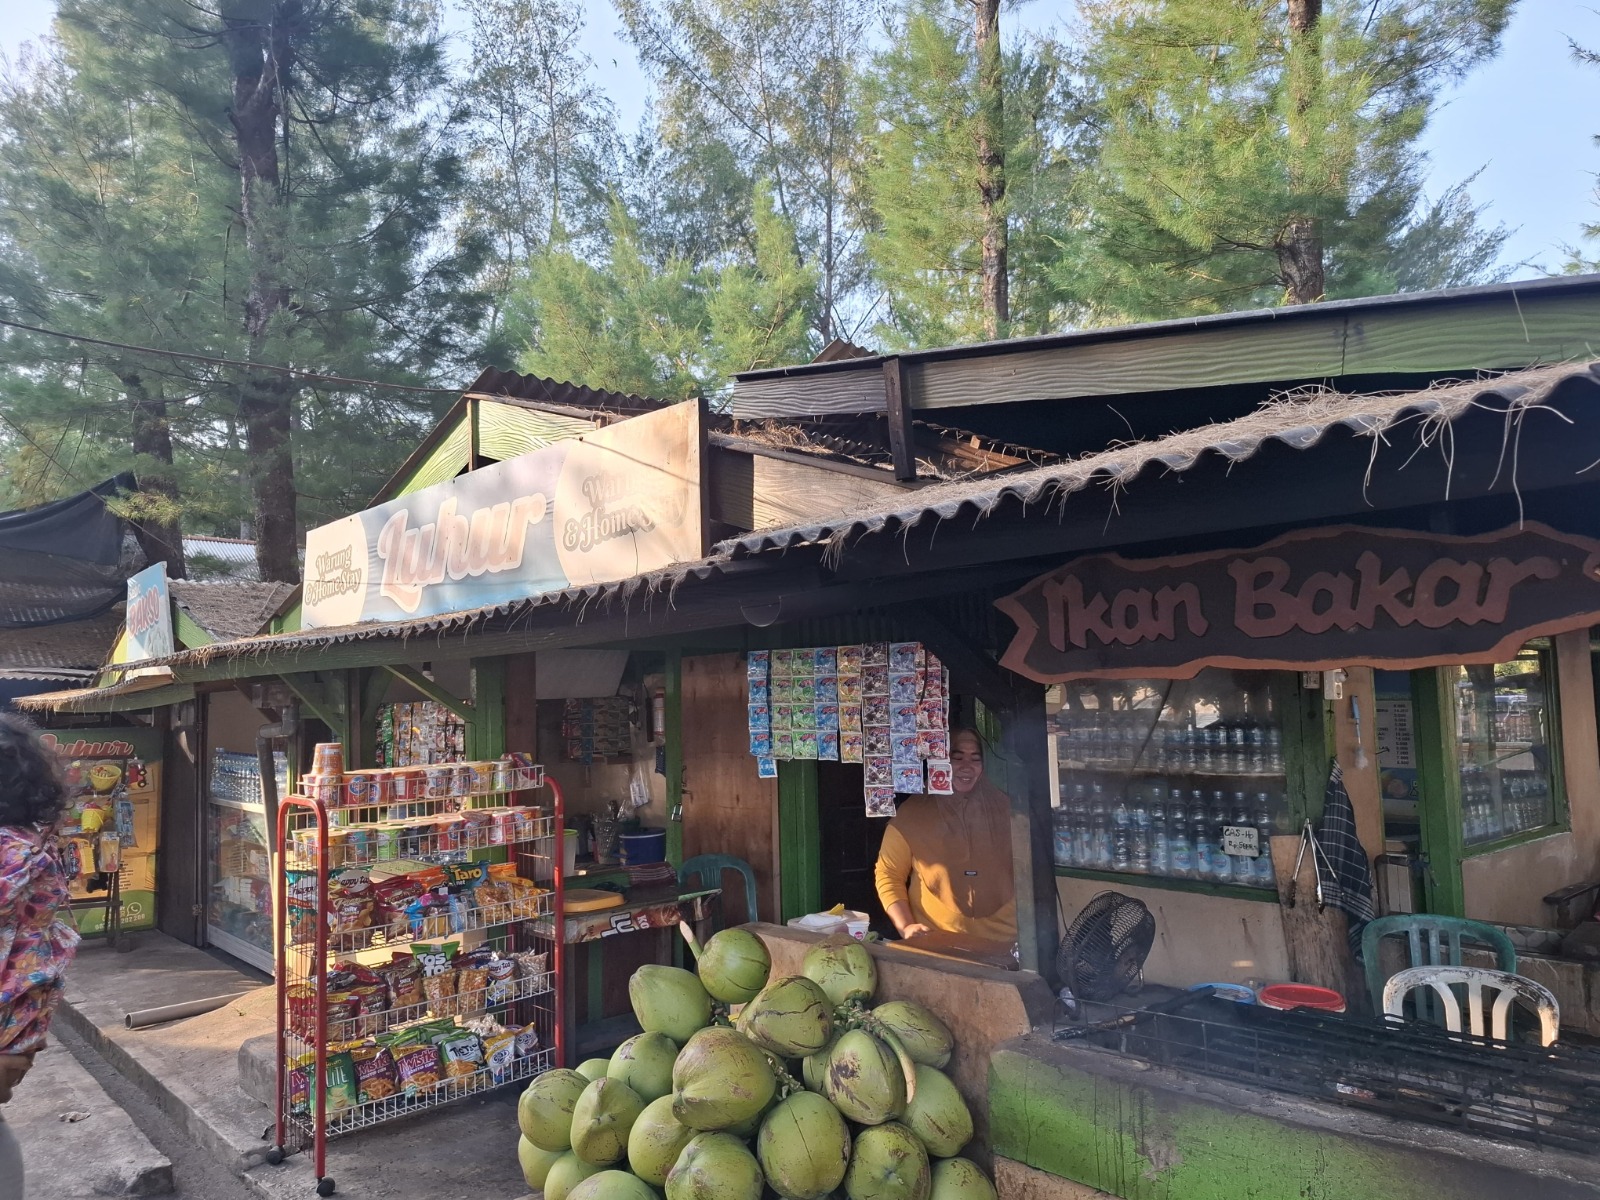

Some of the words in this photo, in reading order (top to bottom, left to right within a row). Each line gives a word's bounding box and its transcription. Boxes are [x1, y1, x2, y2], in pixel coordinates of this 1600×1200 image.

[315, 544, 352, 577] Warung
[377, 492, 547, 613] Luhur
[128, 585, 160, 640] BAKSO
[1043, 573, 1209, 653] Ikan
[1228, 549, 1562, 639] Bakar
[338, 876, 359, 889] appy
[453, 867, 482, 881] Taro
[416, 952, 446, 966] TOS
